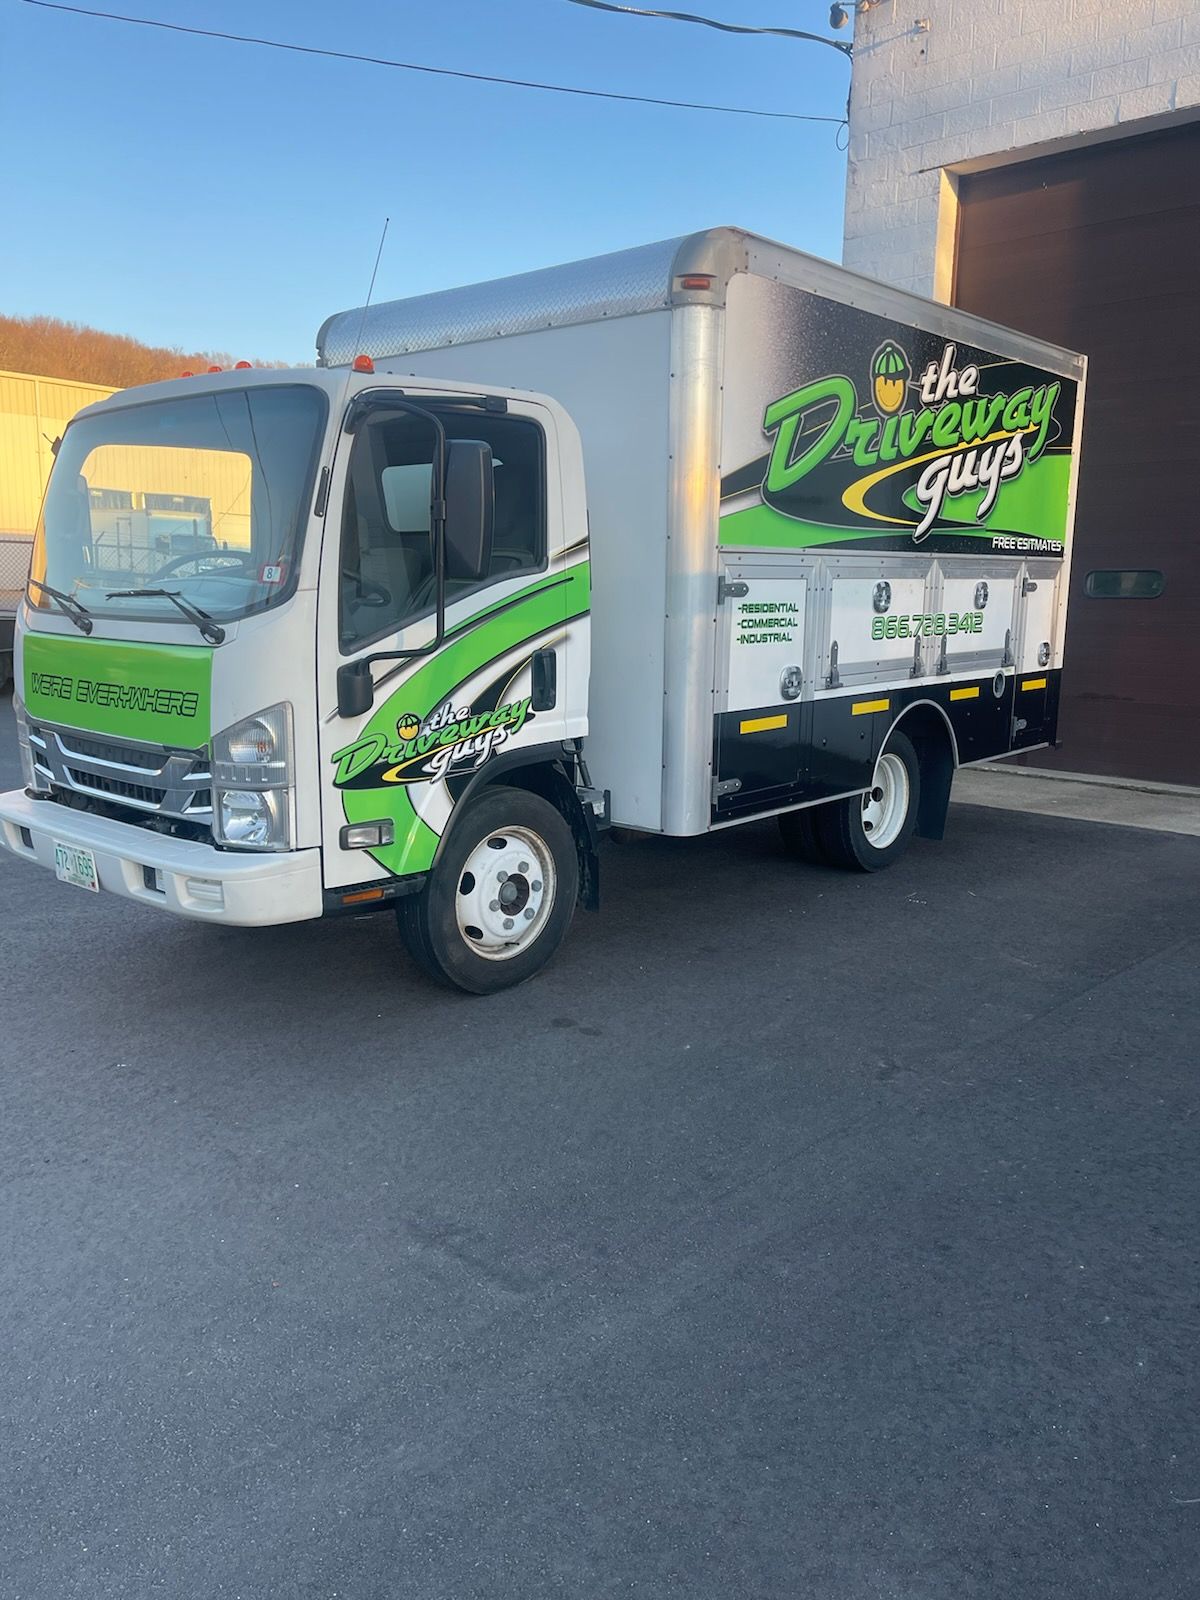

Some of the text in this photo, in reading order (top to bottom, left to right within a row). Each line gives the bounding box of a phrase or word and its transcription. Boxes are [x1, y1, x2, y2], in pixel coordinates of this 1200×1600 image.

[919, 344, 979, 403] the
[763, 375, 1061, 493] Driveway
[913, 432, 1025, 540] guys
[991, 536, 1016, 549] FREE
[266, 567, 273, 579] 8
[737, 617, 798, 629] -COMMERCIAL
[738, 602, 799, 614] -RESIDENTIAL
[736, 632, 792, 645] -INDUSTRIAL
[871, 611, 984, 641] 866.728.3412
[76, 679, 199, 718] EVERYWHERE
[428, 702, 470, 732] the
[331, 696, 533, 785] Driveway
[429, 724, 508, 785] guys
